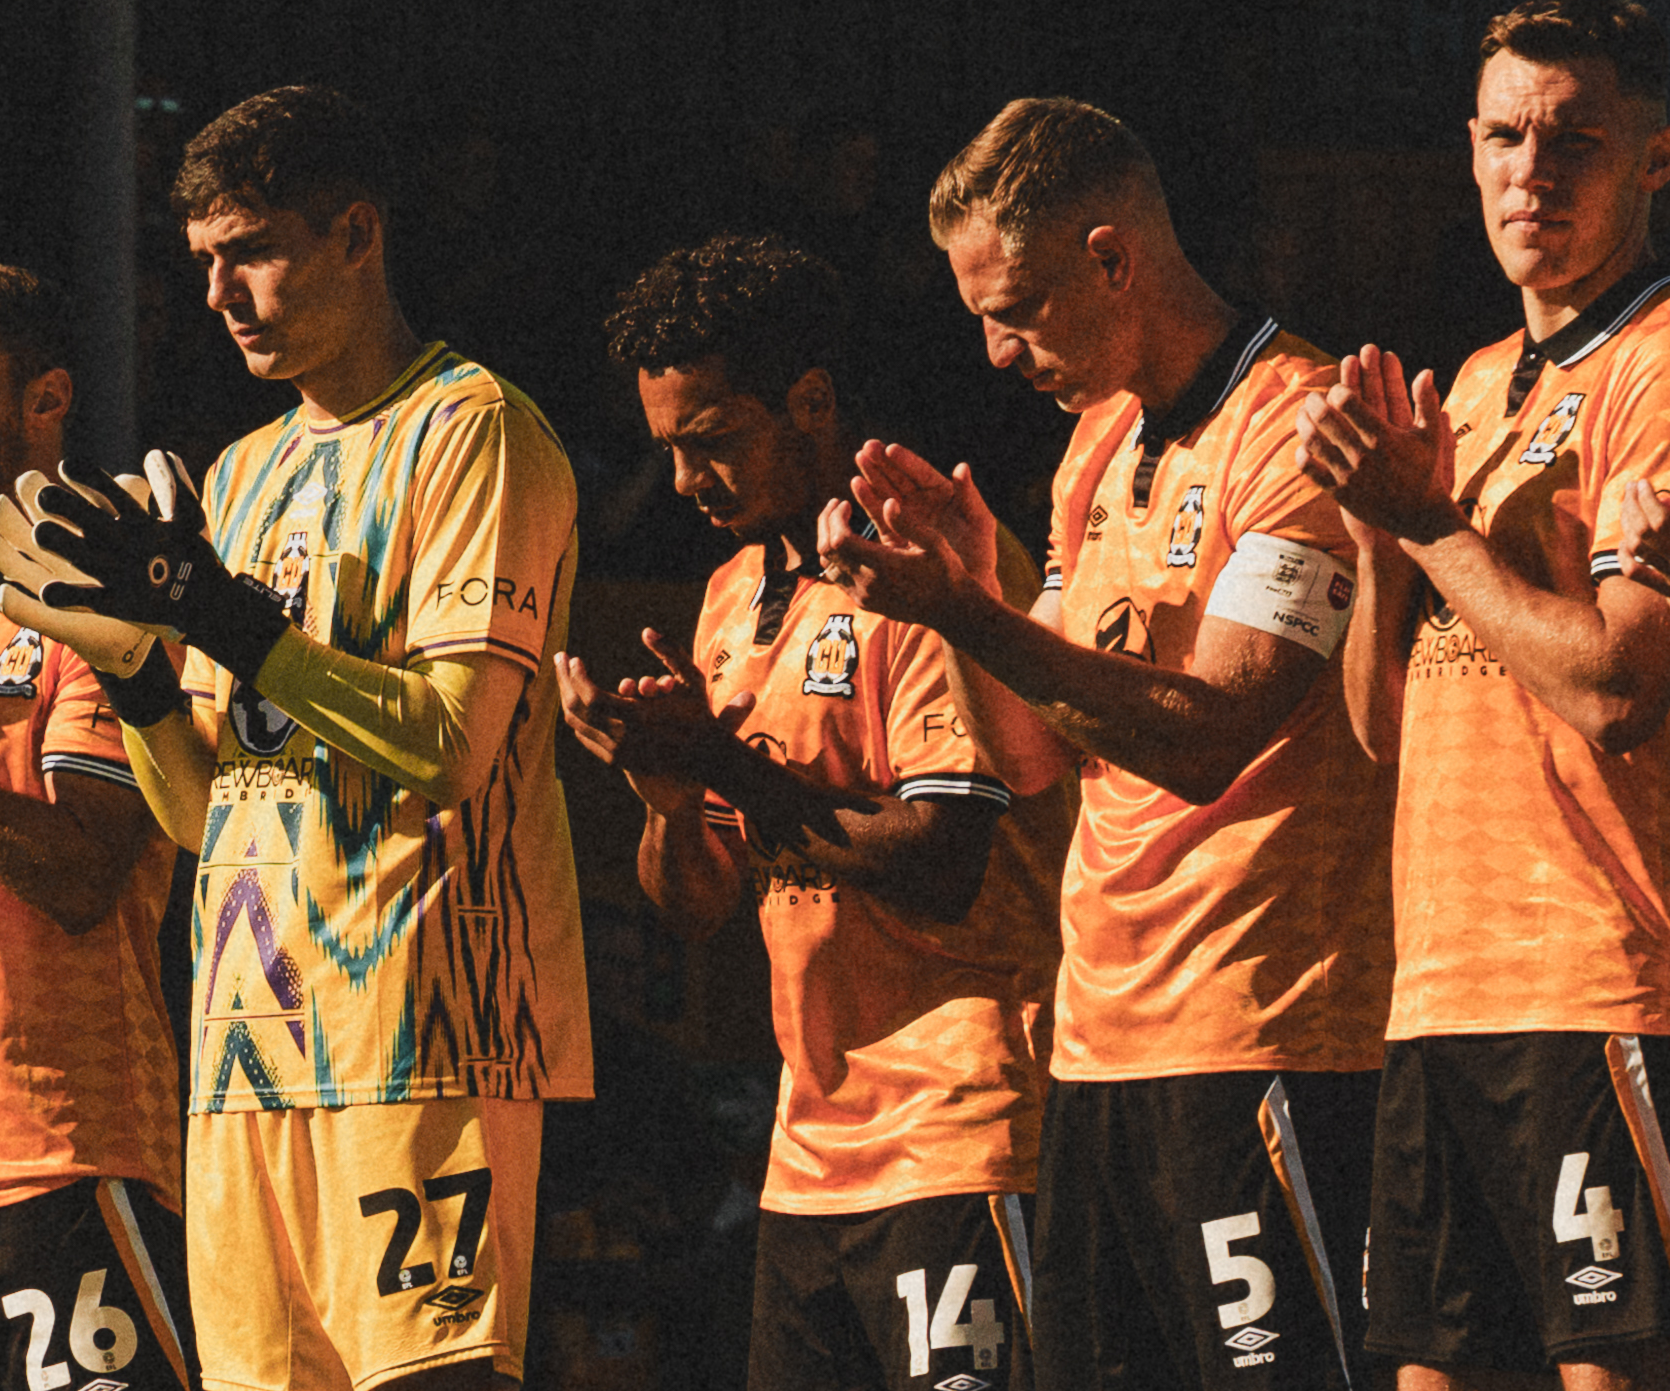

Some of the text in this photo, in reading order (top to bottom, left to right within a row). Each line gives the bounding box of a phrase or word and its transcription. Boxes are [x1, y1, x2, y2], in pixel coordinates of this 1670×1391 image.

[437, 577, 539, 620] FORA
[1273, 611, 1320, 637] NSPCC
[1552, 1152, 1625, 1262] 4
[358, 1166, 492, 1298] 27
[1201, 1211, 1276, 1329] 5
[433, 1308, 482, 1329] umbro
[897, 1259, 1005, 1377] 14
[1574, 1290, 1618, 1306] umbro
[1233, 1350, 1276, 1368] umbro
